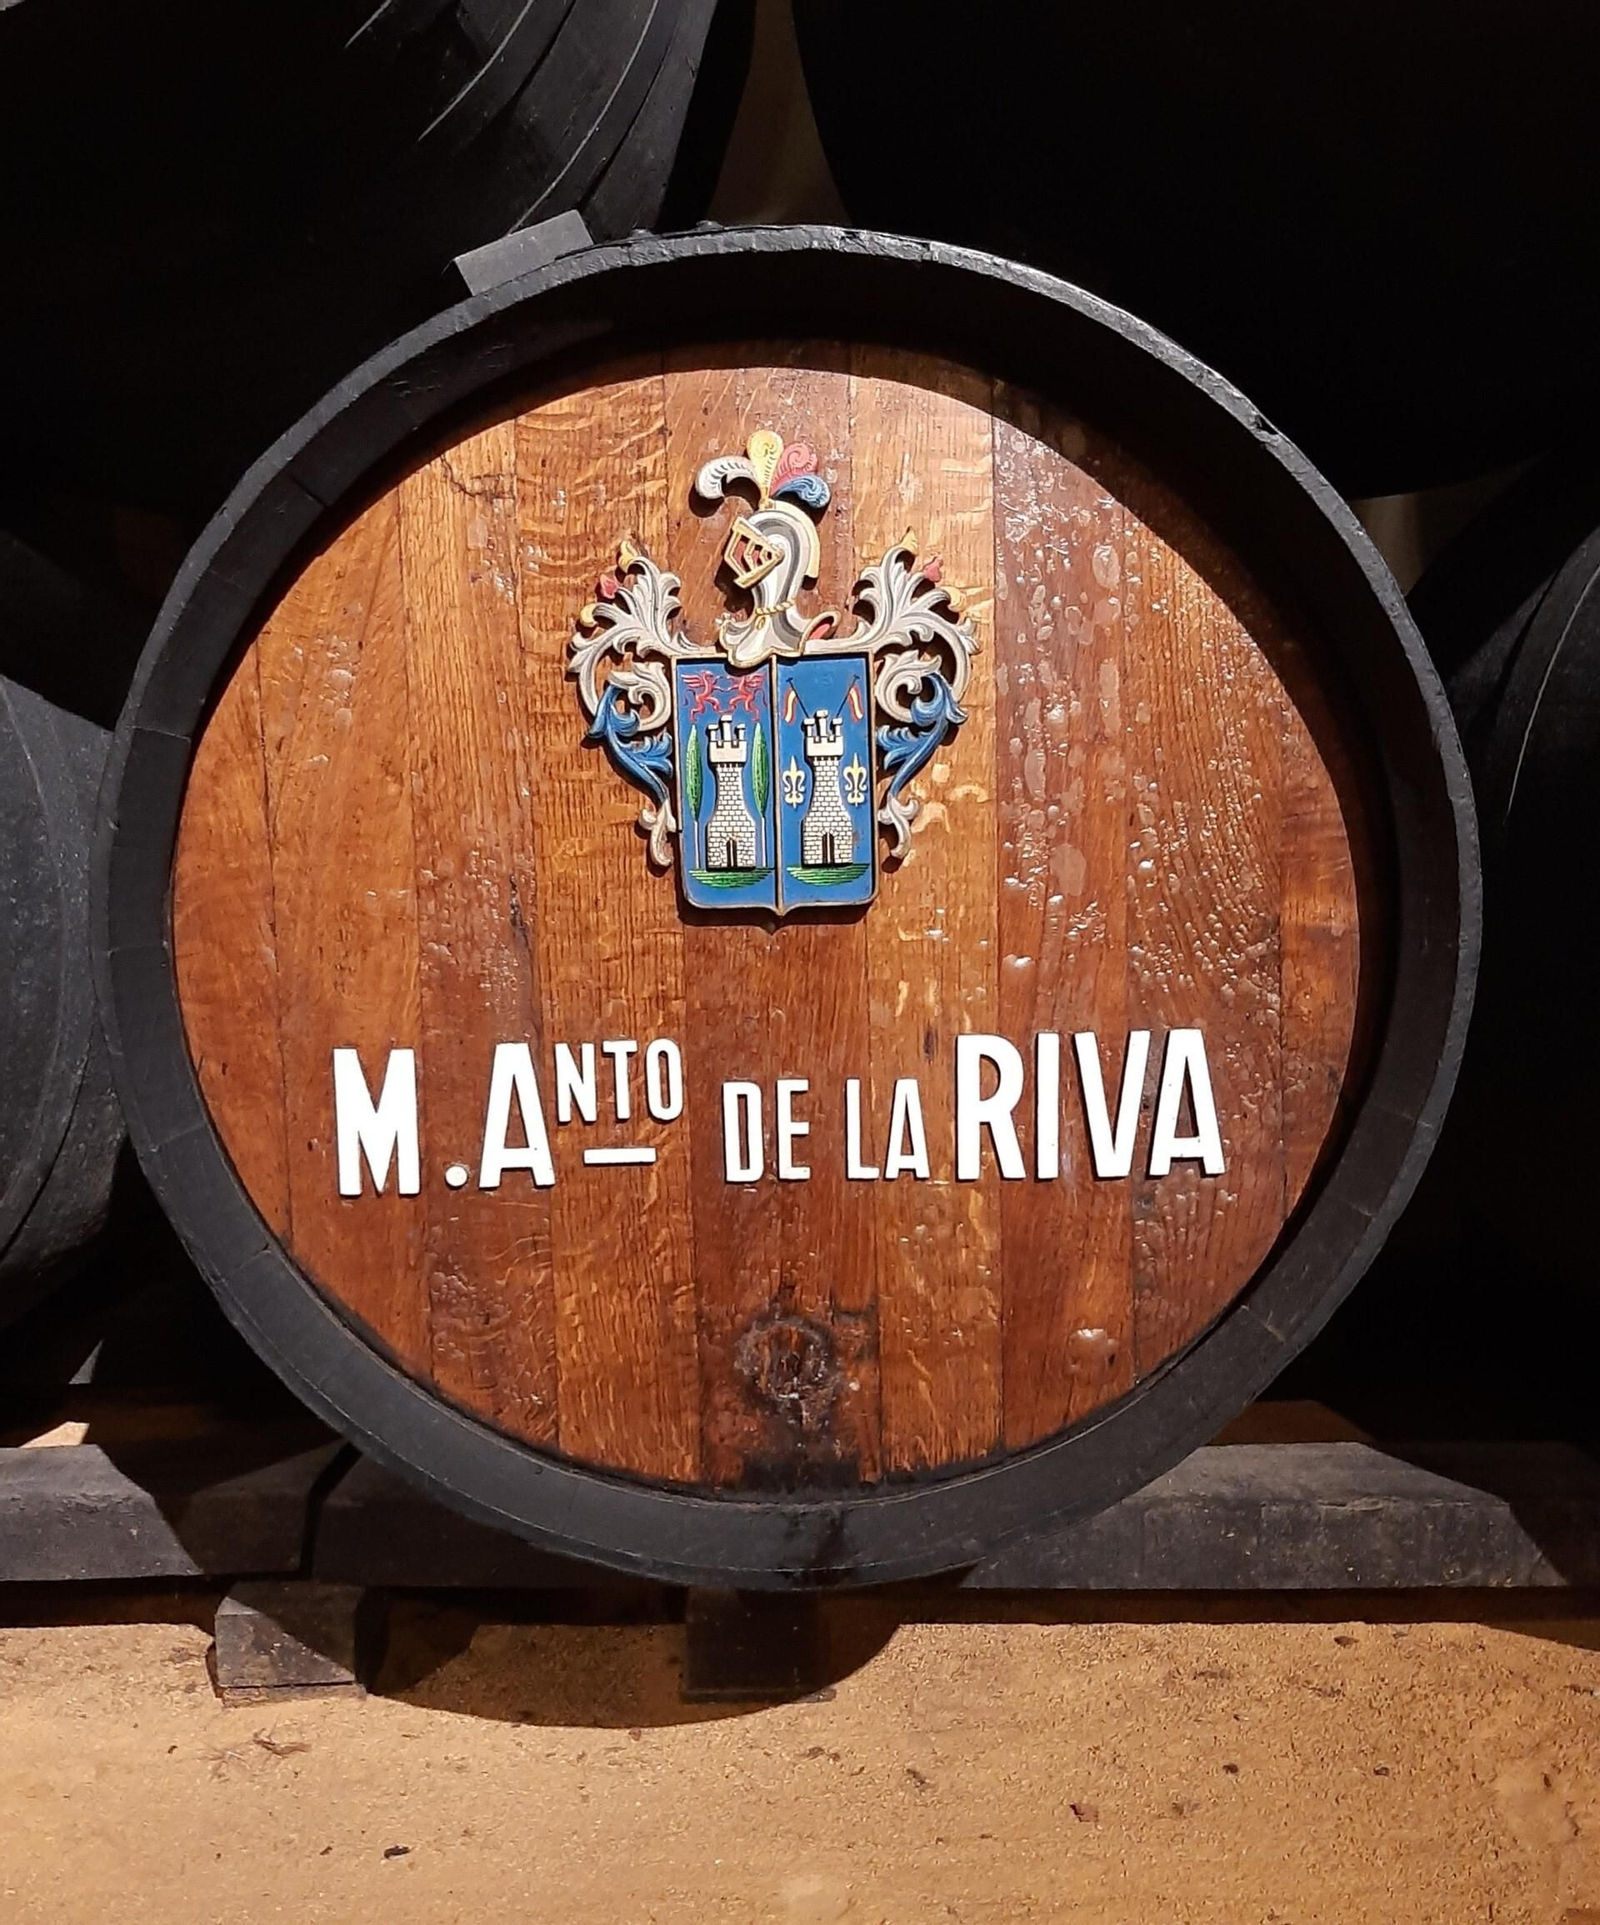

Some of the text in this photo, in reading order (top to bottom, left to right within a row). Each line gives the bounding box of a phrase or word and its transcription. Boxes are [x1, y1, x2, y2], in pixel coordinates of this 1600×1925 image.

[722, 1079, 811, 1182] DE
[846, 1078, 931, 1180] LA
[956, 1028, 1226, 1181] RIVA
